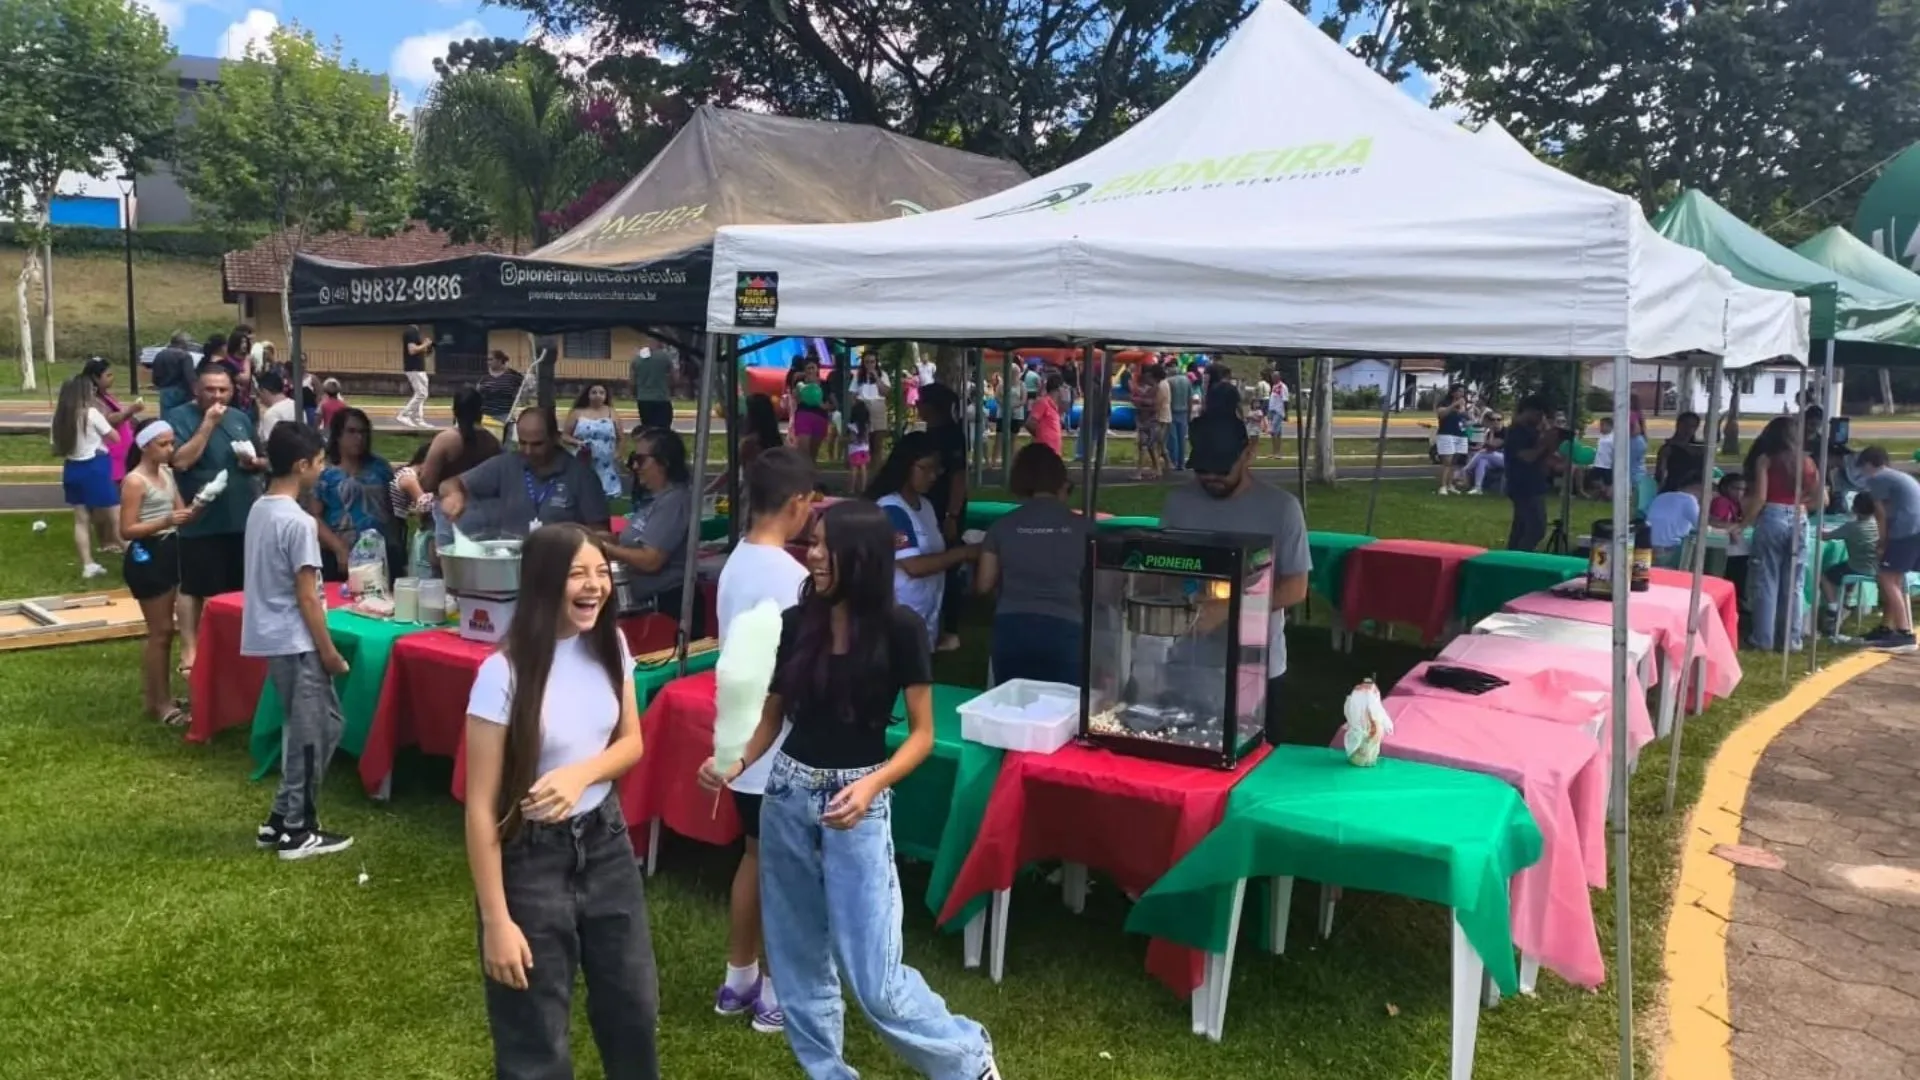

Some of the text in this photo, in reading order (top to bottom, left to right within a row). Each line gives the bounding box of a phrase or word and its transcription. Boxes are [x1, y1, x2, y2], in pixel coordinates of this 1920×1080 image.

[1093, 137, 1374, 197] PIONEIRA
[351, 273, 462, 304] 99832-9886
[1145, 554, 1202, 570] PIONEIRA
